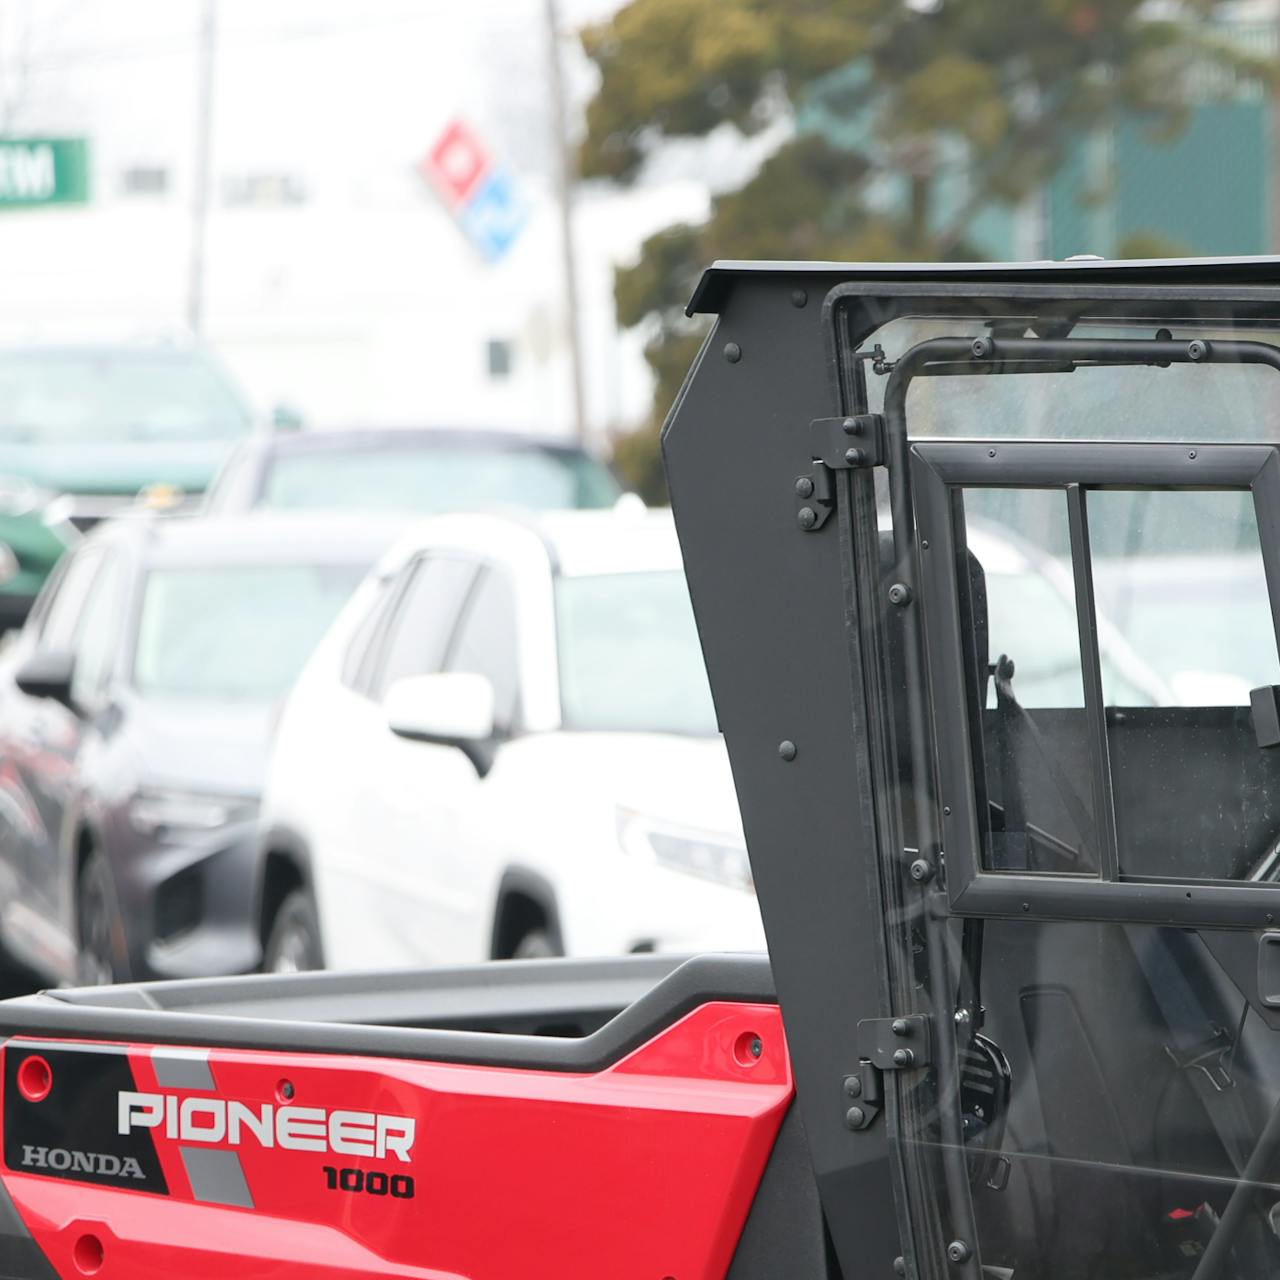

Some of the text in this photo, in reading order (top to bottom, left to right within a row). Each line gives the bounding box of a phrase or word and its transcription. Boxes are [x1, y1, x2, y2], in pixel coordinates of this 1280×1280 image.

[117, 1090, 416, 1163] PIONEER
[21, 1145, 146, 1180] HONDA
[322, 1165, 415, 1200] 1000
